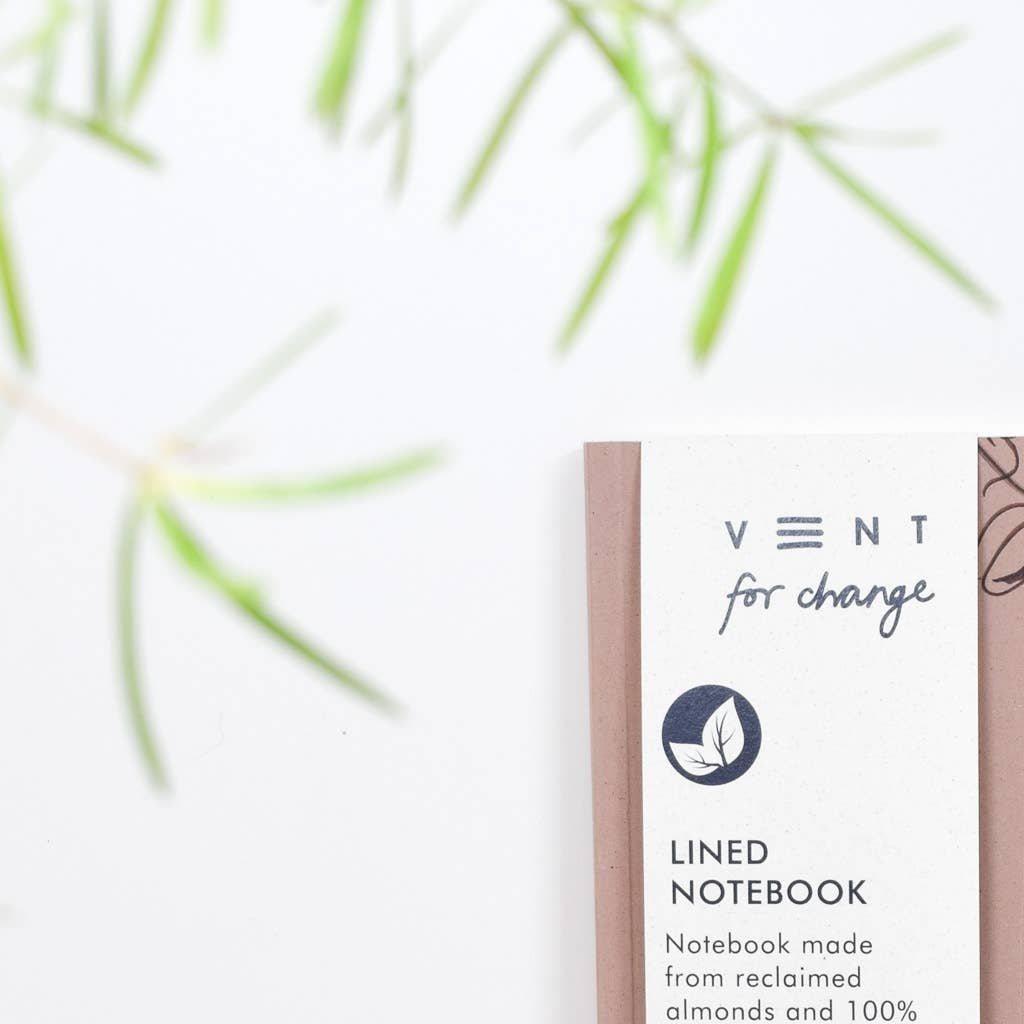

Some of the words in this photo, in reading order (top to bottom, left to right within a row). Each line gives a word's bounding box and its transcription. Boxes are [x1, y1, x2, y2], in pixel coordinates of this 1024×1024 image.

[718, 571, 786, 636] for
[796, 570, 936, 639] change
[671, 839, 769, 865] LINED
[671, 878, 868, 906] NOTEBOOK
[665, 931, 791, 955] Notebook
[802, 931, 873, 955] made
[664, 964, 724, 988] from
[736, 964, 861, 989] reclaimed
[666, 998, 775, 1022] almonds
[786, 998, 833, 1022] and
[847, 999, 918, 1022] 100%
